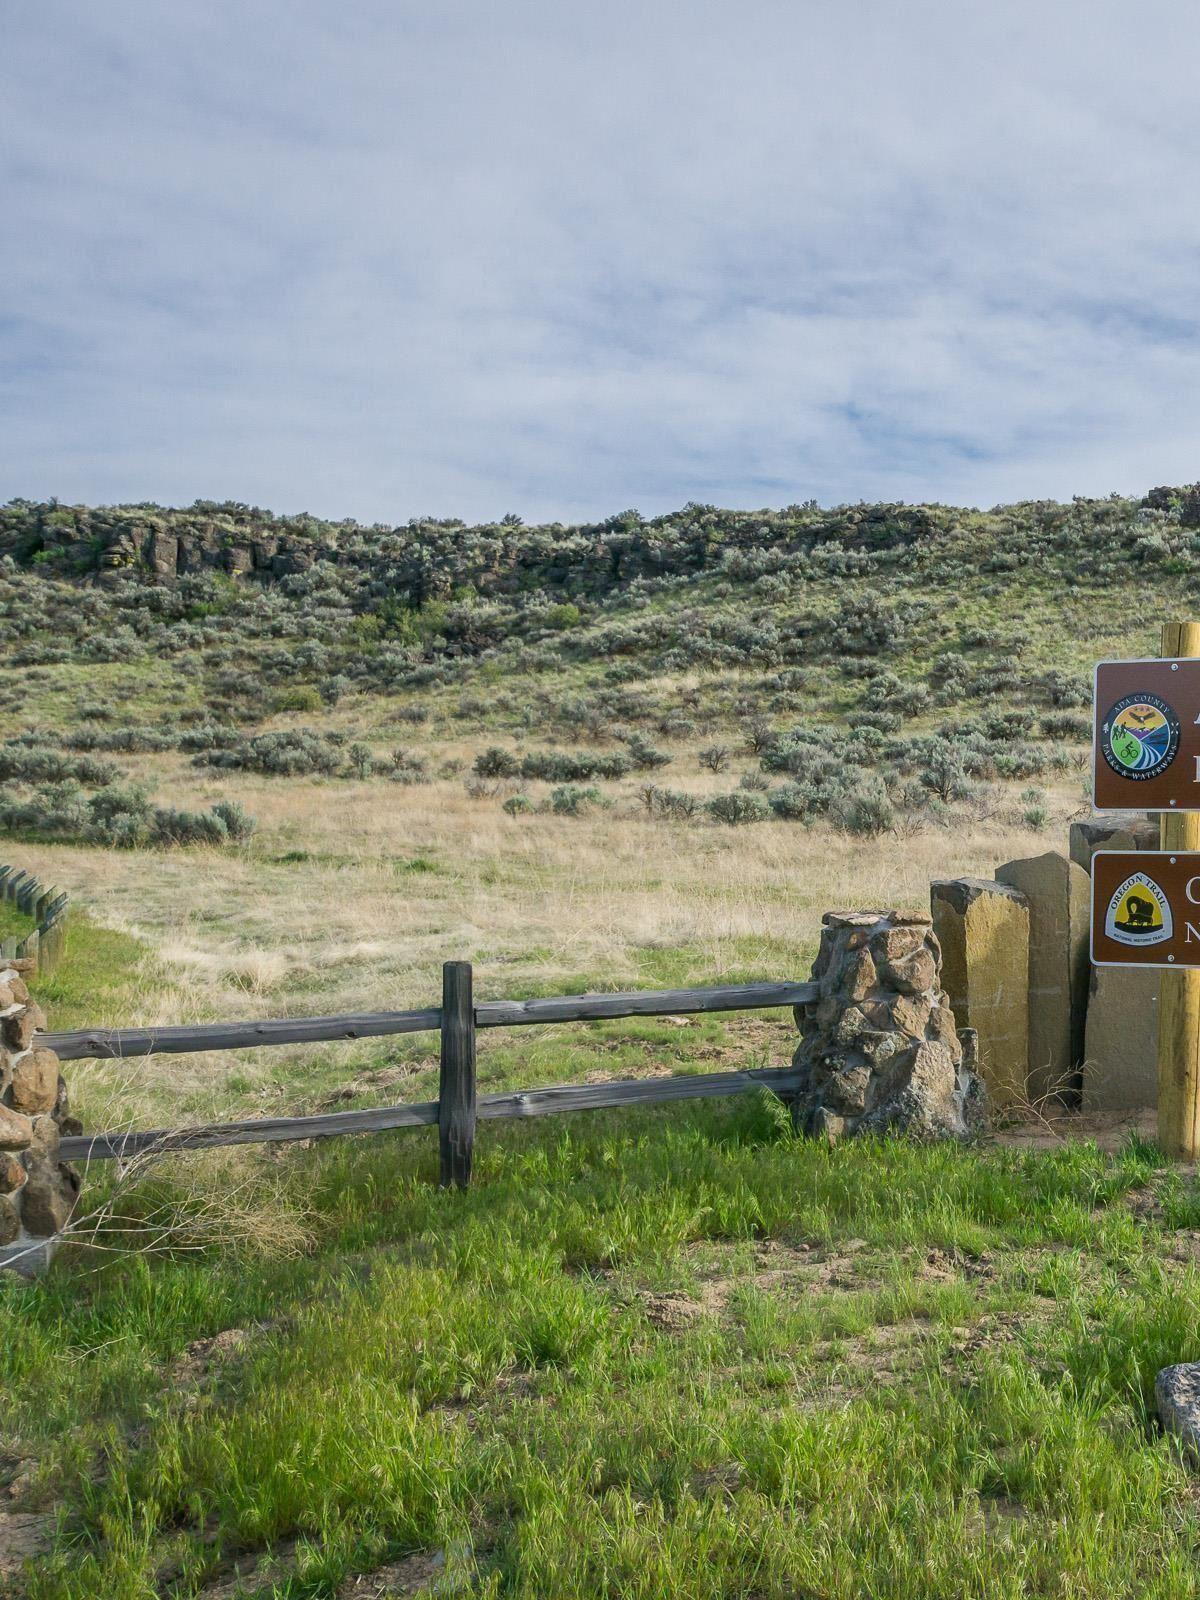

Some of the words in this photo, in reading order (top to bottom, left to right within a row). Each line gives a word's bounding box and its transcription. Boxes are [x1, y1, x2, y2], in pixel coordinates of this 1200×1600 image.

[1113, 700, 1131, 713] ADA
[1134, 695, 1170, 713] COUNTY
[1103, 743, 1119, 770] PARKS
[1132, 745, 1177, 780] WATERWAYS
[1111, 876, 1143, 909] OREGON
[1146, 879, 1165, 908] TRAIL
